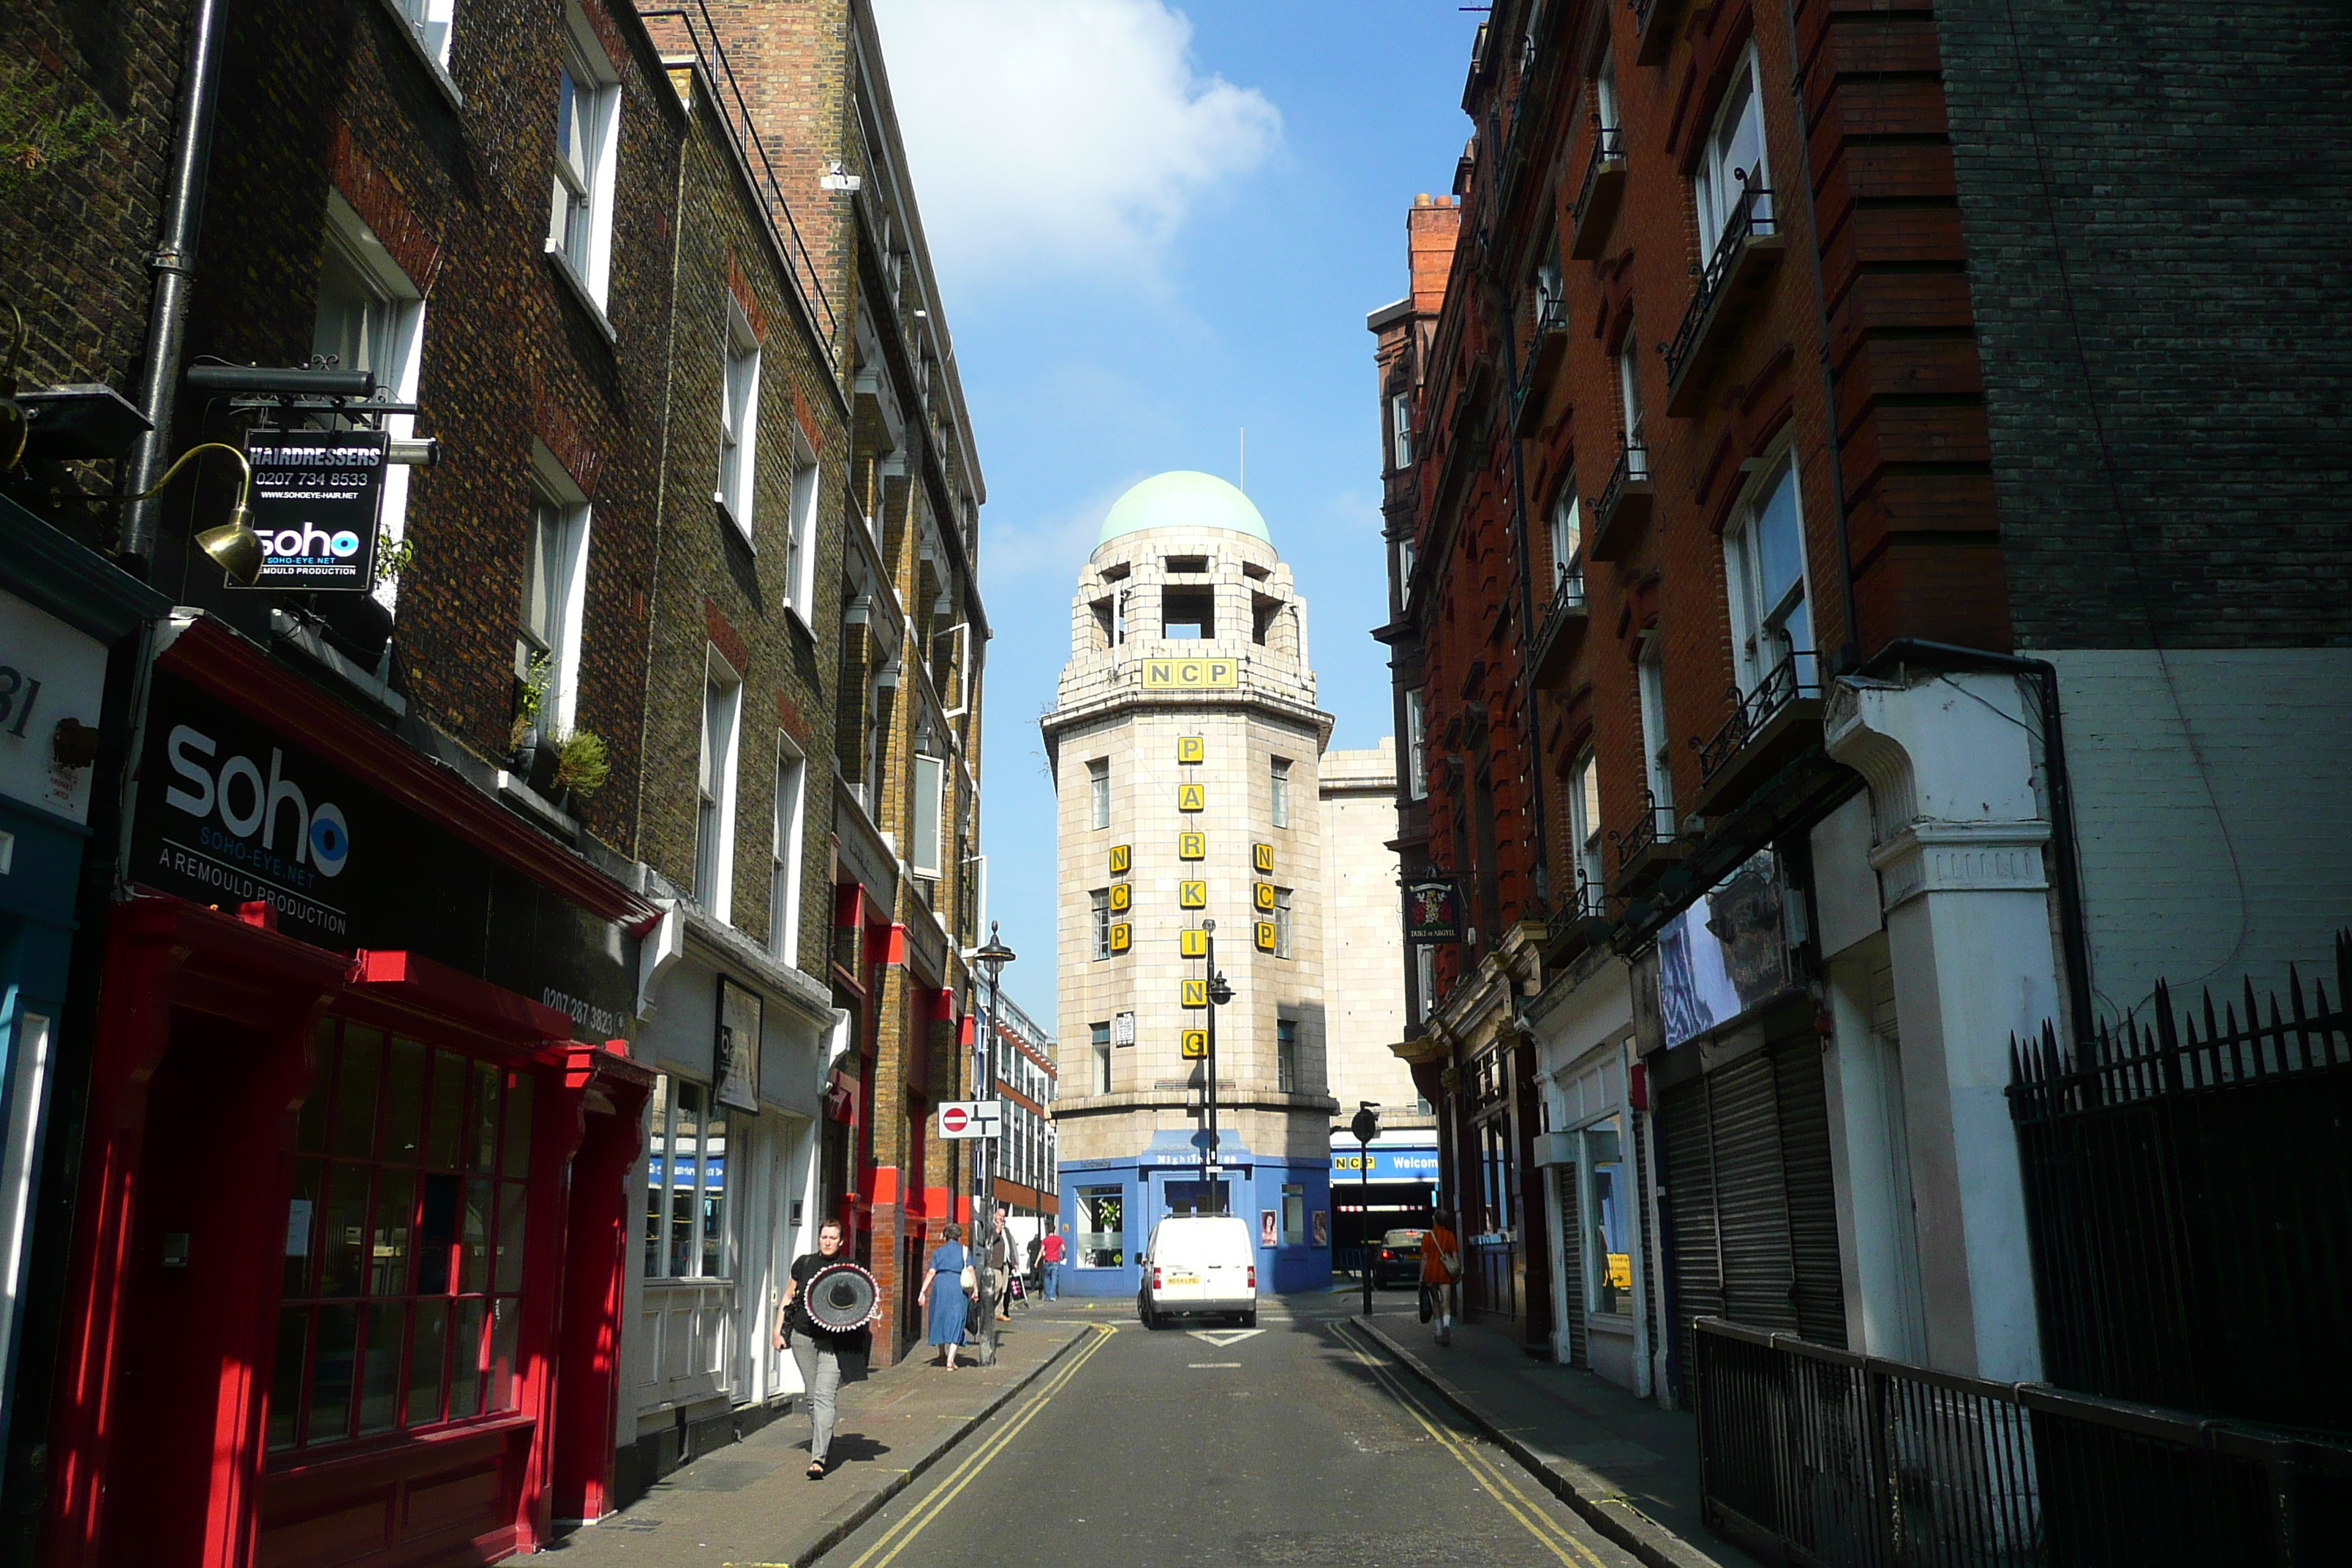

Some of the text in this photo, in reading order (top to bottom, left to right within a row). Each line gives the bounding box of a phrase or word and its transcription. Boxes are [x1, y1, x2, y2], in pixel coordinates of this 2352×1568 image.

[249, 448, 381, 466] HAIRDRESSERS
[256, 472, 367, 486] 0207 734 8533
[296, 568, 356, 576] PRODUCTION
[1152, 665, 1226, 682] NCP
[200, 827, 314, 889] SOHO-EYE.NET
[159, 848, 346, 935] A REMOULD PRODUCTION
[1113, 848, 1126, 947] NCP
[1184, 743, 1203, 1052] PARKING
[1257, 848, 1273, 946] NCP
[543, 987, 613, 1036] 0207 287 3823
[1157, 1153, 1237, 1165] Nightingles
[1336, 1158, 1373, 1168] NCP
